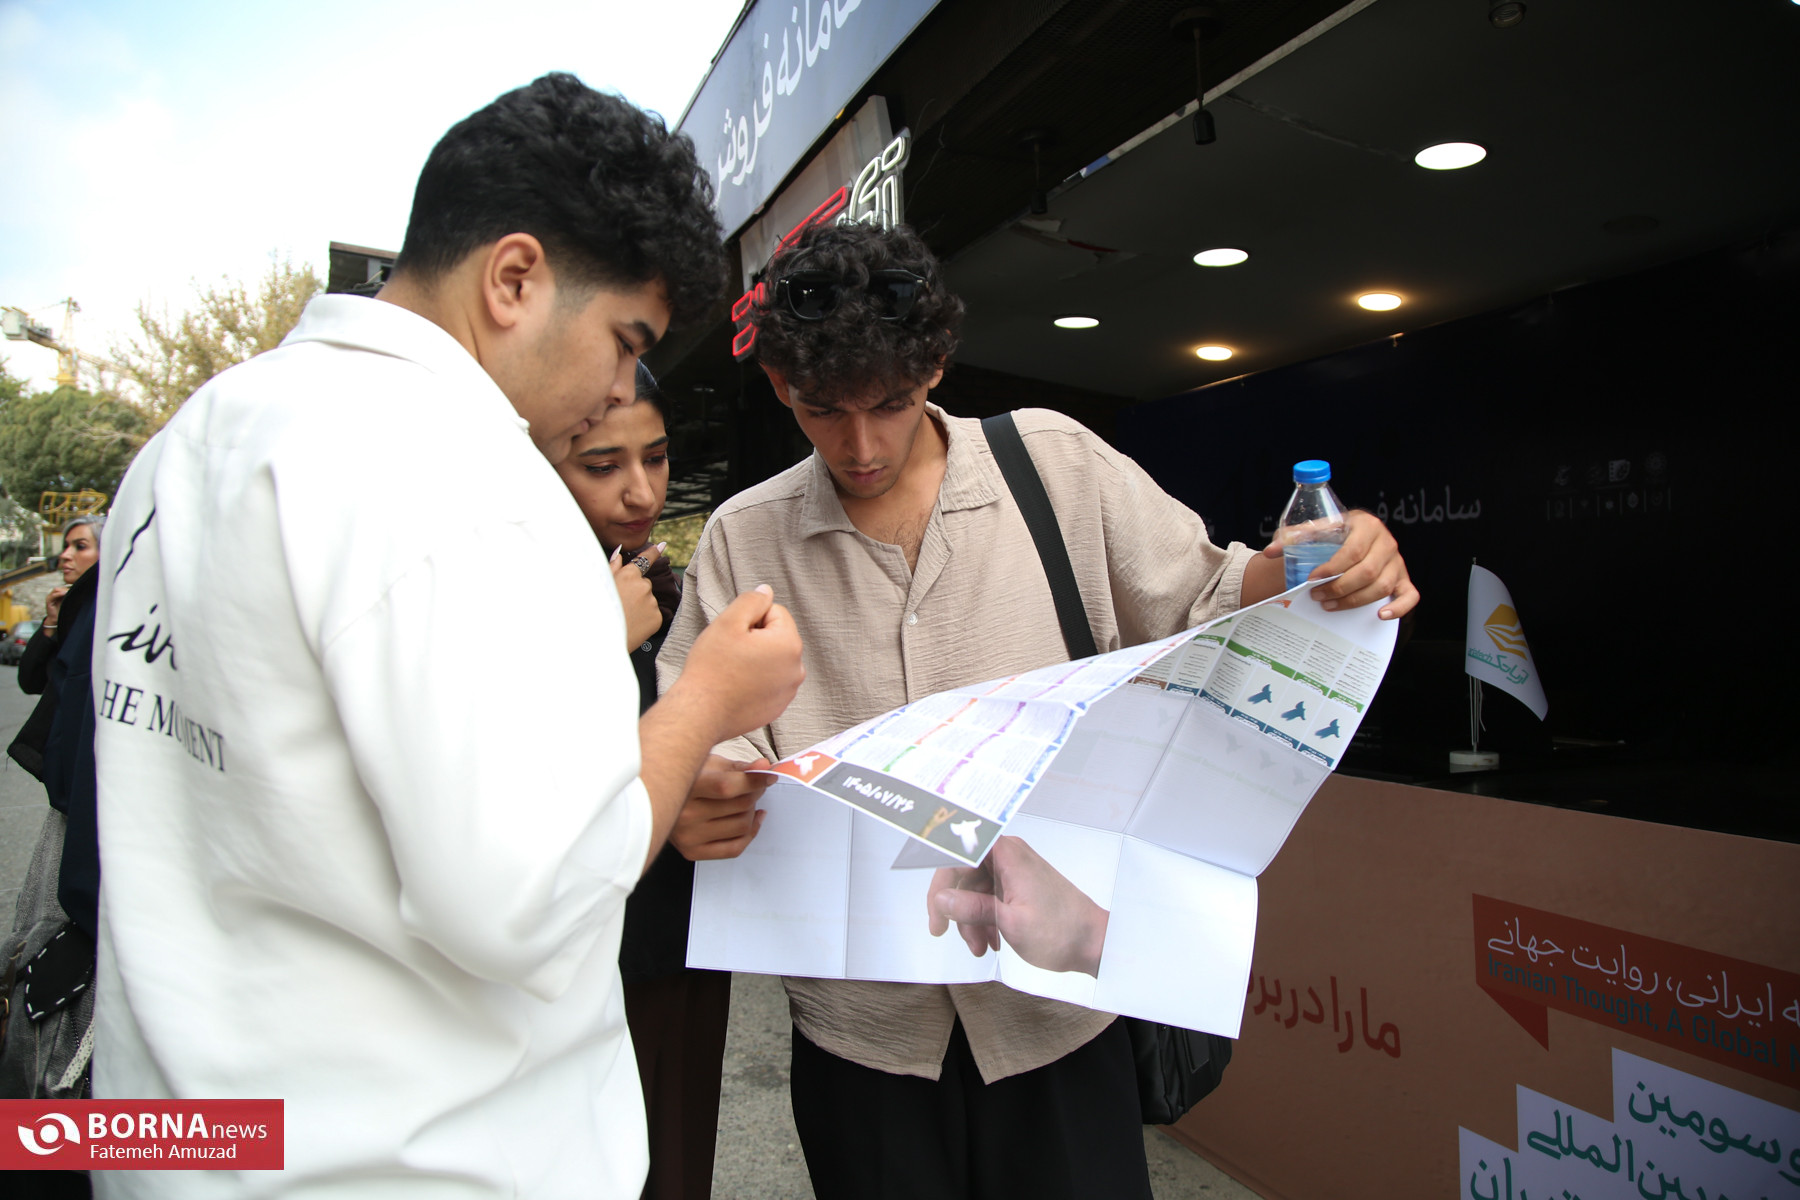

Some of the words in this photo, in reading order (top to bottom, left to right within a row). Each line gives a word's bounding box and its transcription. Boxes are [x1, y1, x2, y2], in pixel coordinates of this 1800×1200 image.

[99, 679, 144, 726] HE
[1572, 944, 1658, 994] روایت
[1488, 952, 1556, 996] Iranian
[1562, 974, 1659, 1032] Thought,
[1666, 1007, 1685, 1037] A
[1692, 1015, 1780, 1067] Global
